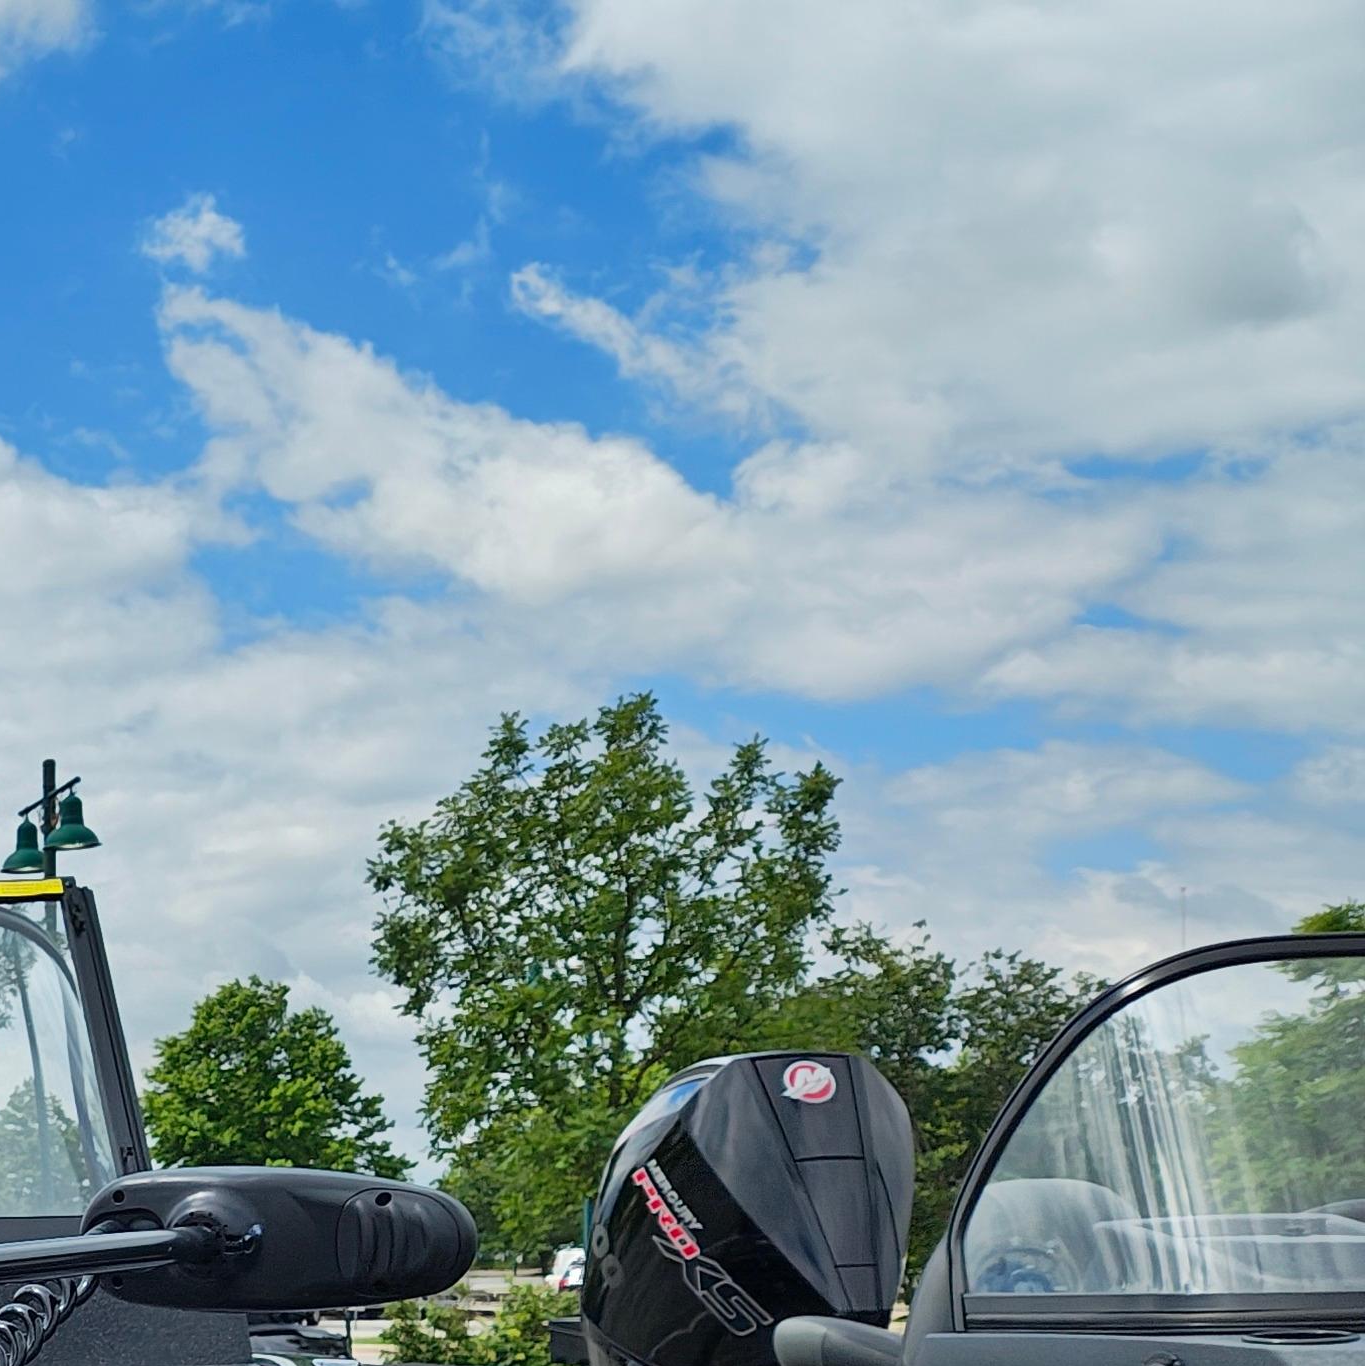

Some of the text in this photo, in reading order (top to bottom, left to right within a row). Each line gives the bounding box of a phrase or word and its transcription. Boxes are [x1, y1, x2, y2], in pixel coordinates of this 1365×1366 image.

[632, 1166, 700, 1260] PRO
[646, 1158, 703, 1230] MERCURY
[652, 1235, 774, 1336] XS
